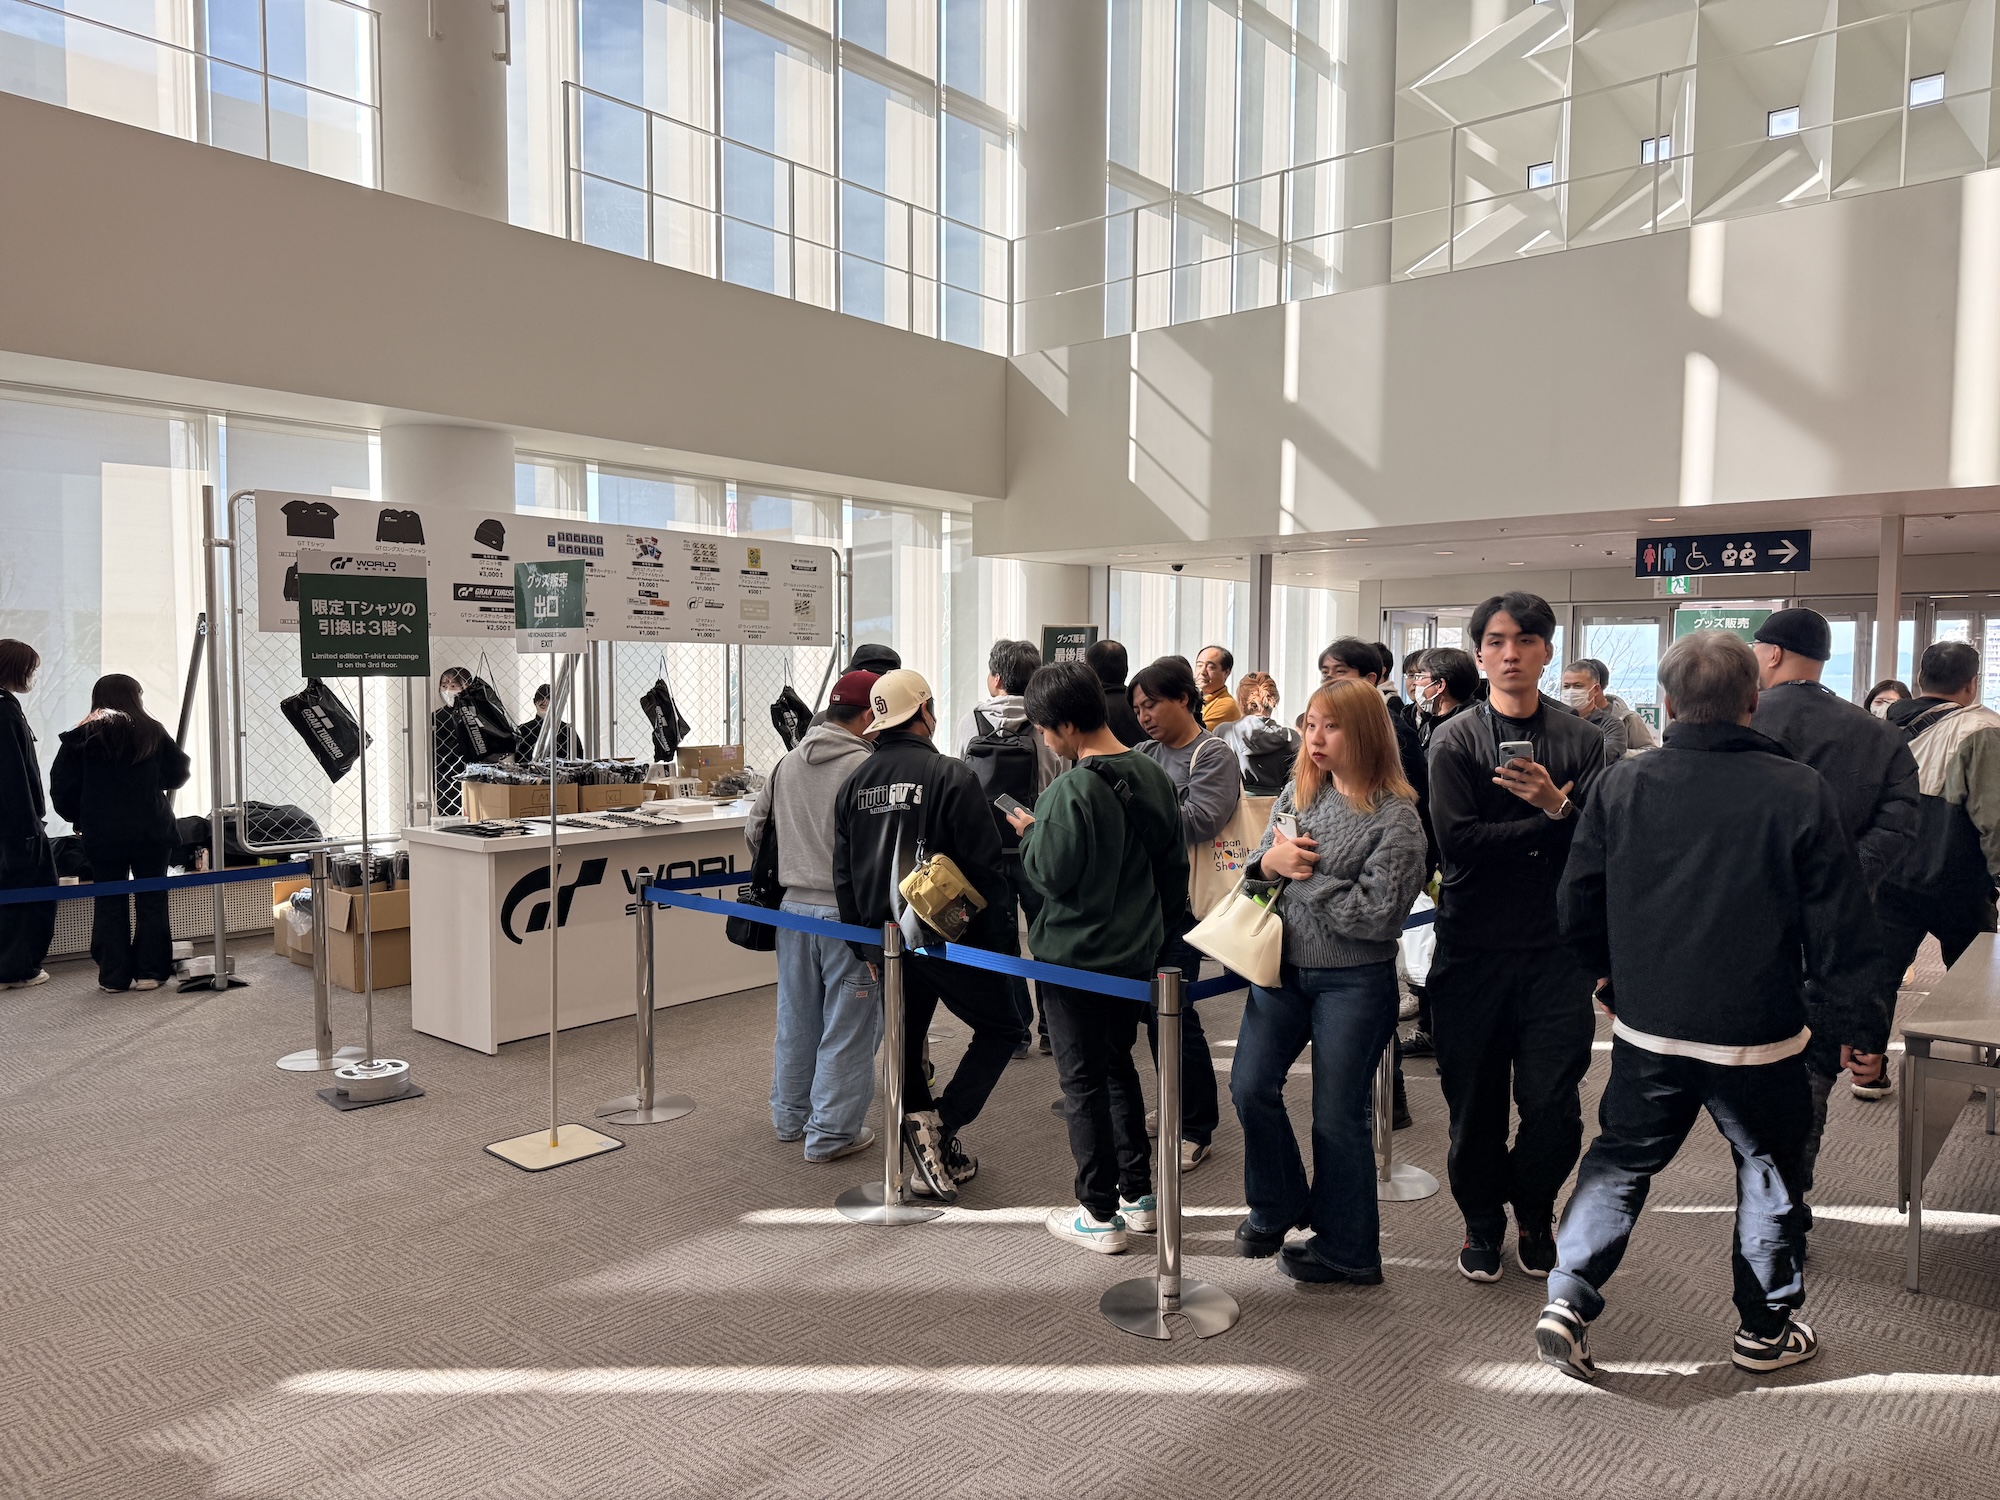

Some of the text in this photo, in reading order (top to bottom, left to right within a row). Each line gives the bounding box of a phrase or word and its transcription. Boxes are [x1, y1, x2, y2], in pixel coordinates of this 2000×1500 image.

[527, 572, 568, 588] グッズ販売
[311, 599, 416, 616] 限定Tシャツの
[534, 594, 559, 617] 出口
[318, 619, 412, 636] 引換は3階へ
[1693, 618, 1749, 629] グッズ販売
[1056, 634, 1086, 643] グッズ販売
[302, 708, 344, 759] GRAN TURISMO
[607, 793, 620, 802] XL
[1211, 839, 1240, 850] Japan
[1214, 848, 1253, 861] Mobilit
[1216, 861, 1244, 872] Show
